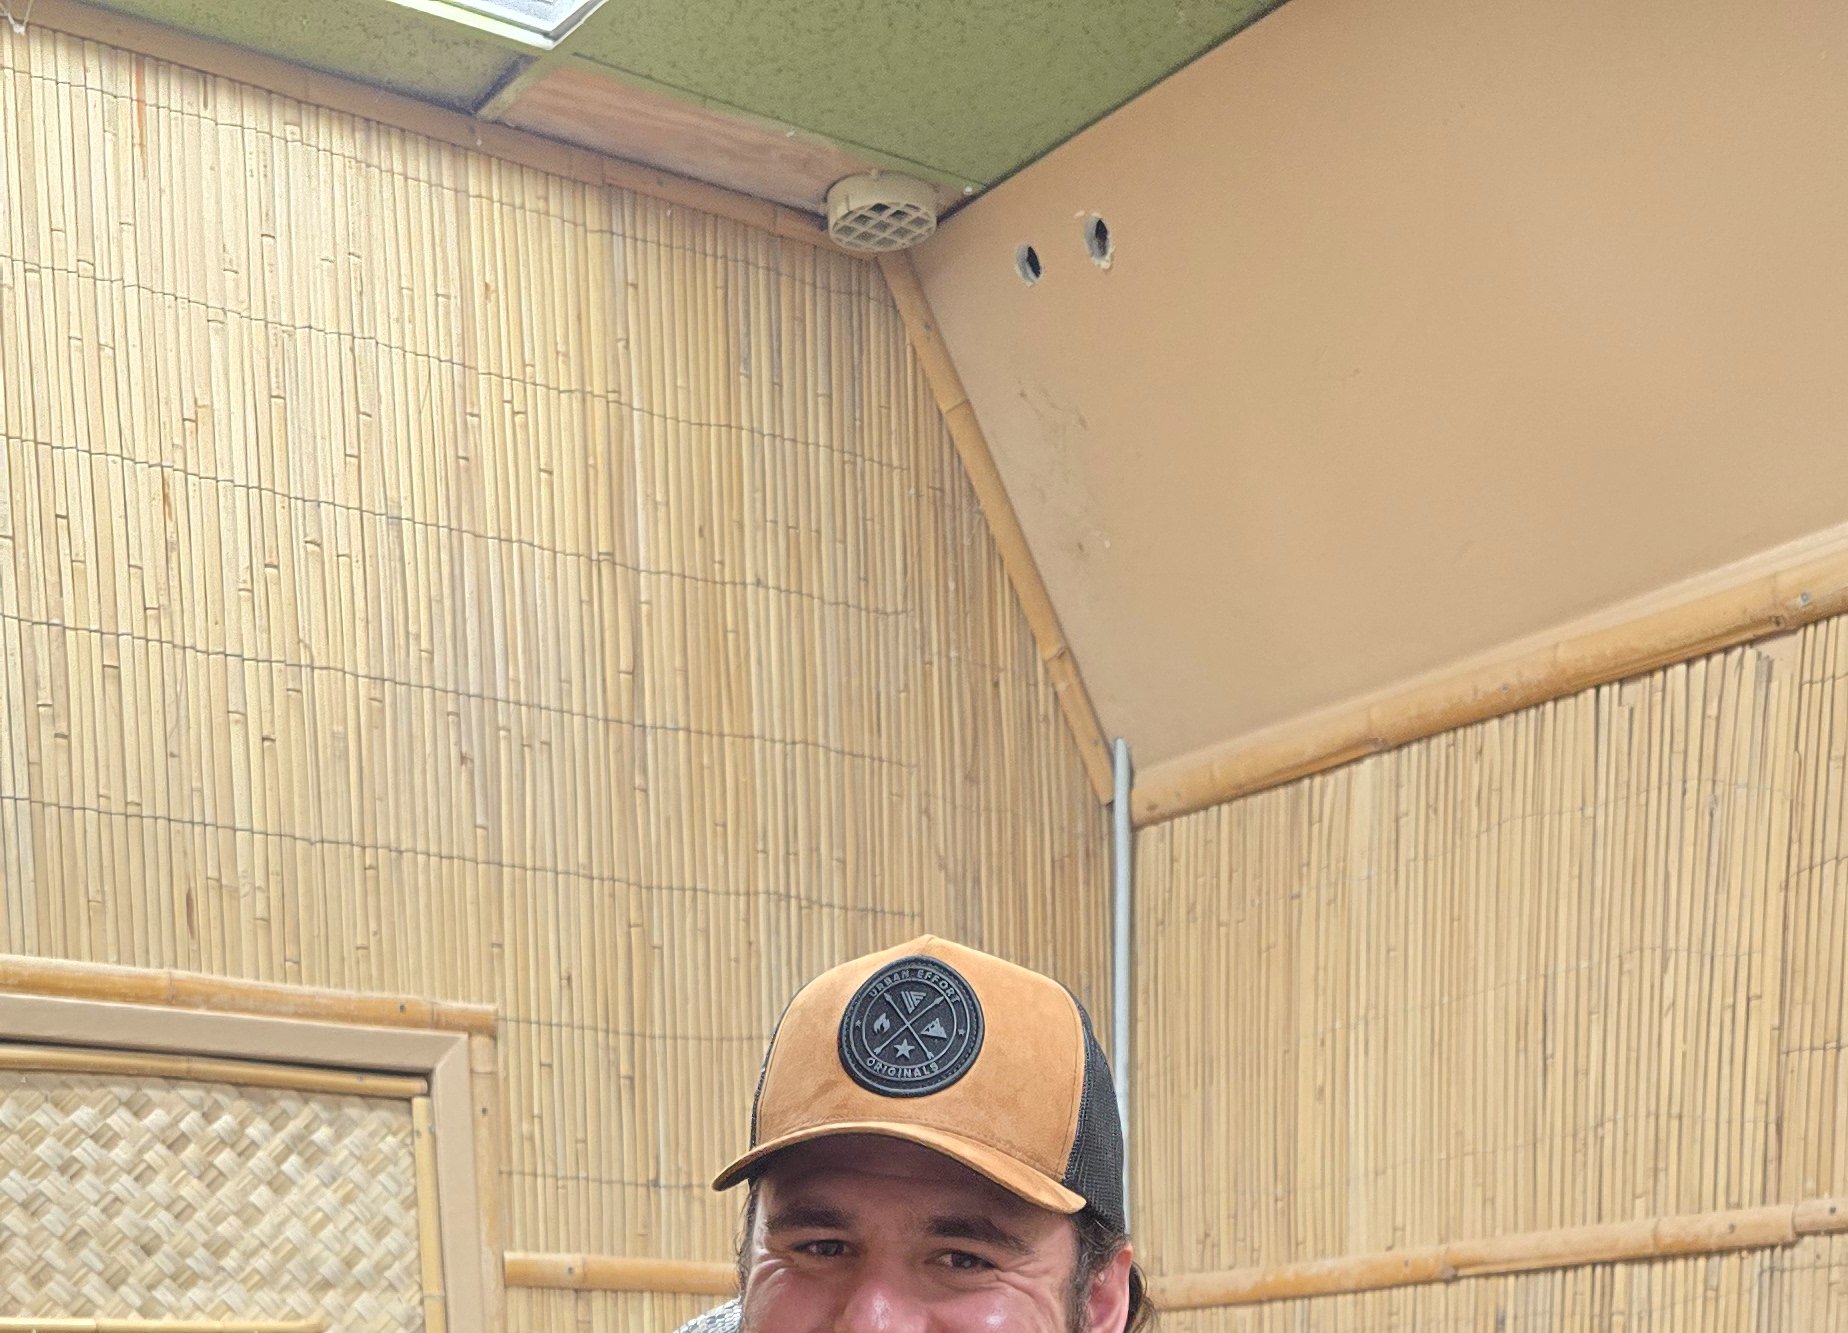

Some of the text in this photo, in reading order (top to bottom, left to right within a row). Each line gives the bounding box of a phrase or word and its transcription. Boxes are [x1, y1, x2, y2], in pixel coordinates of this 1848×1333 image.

[869, 969, 961, 1003] URBAN EFFORT
[866, 1057, 939, 1078] ORIGINALS
